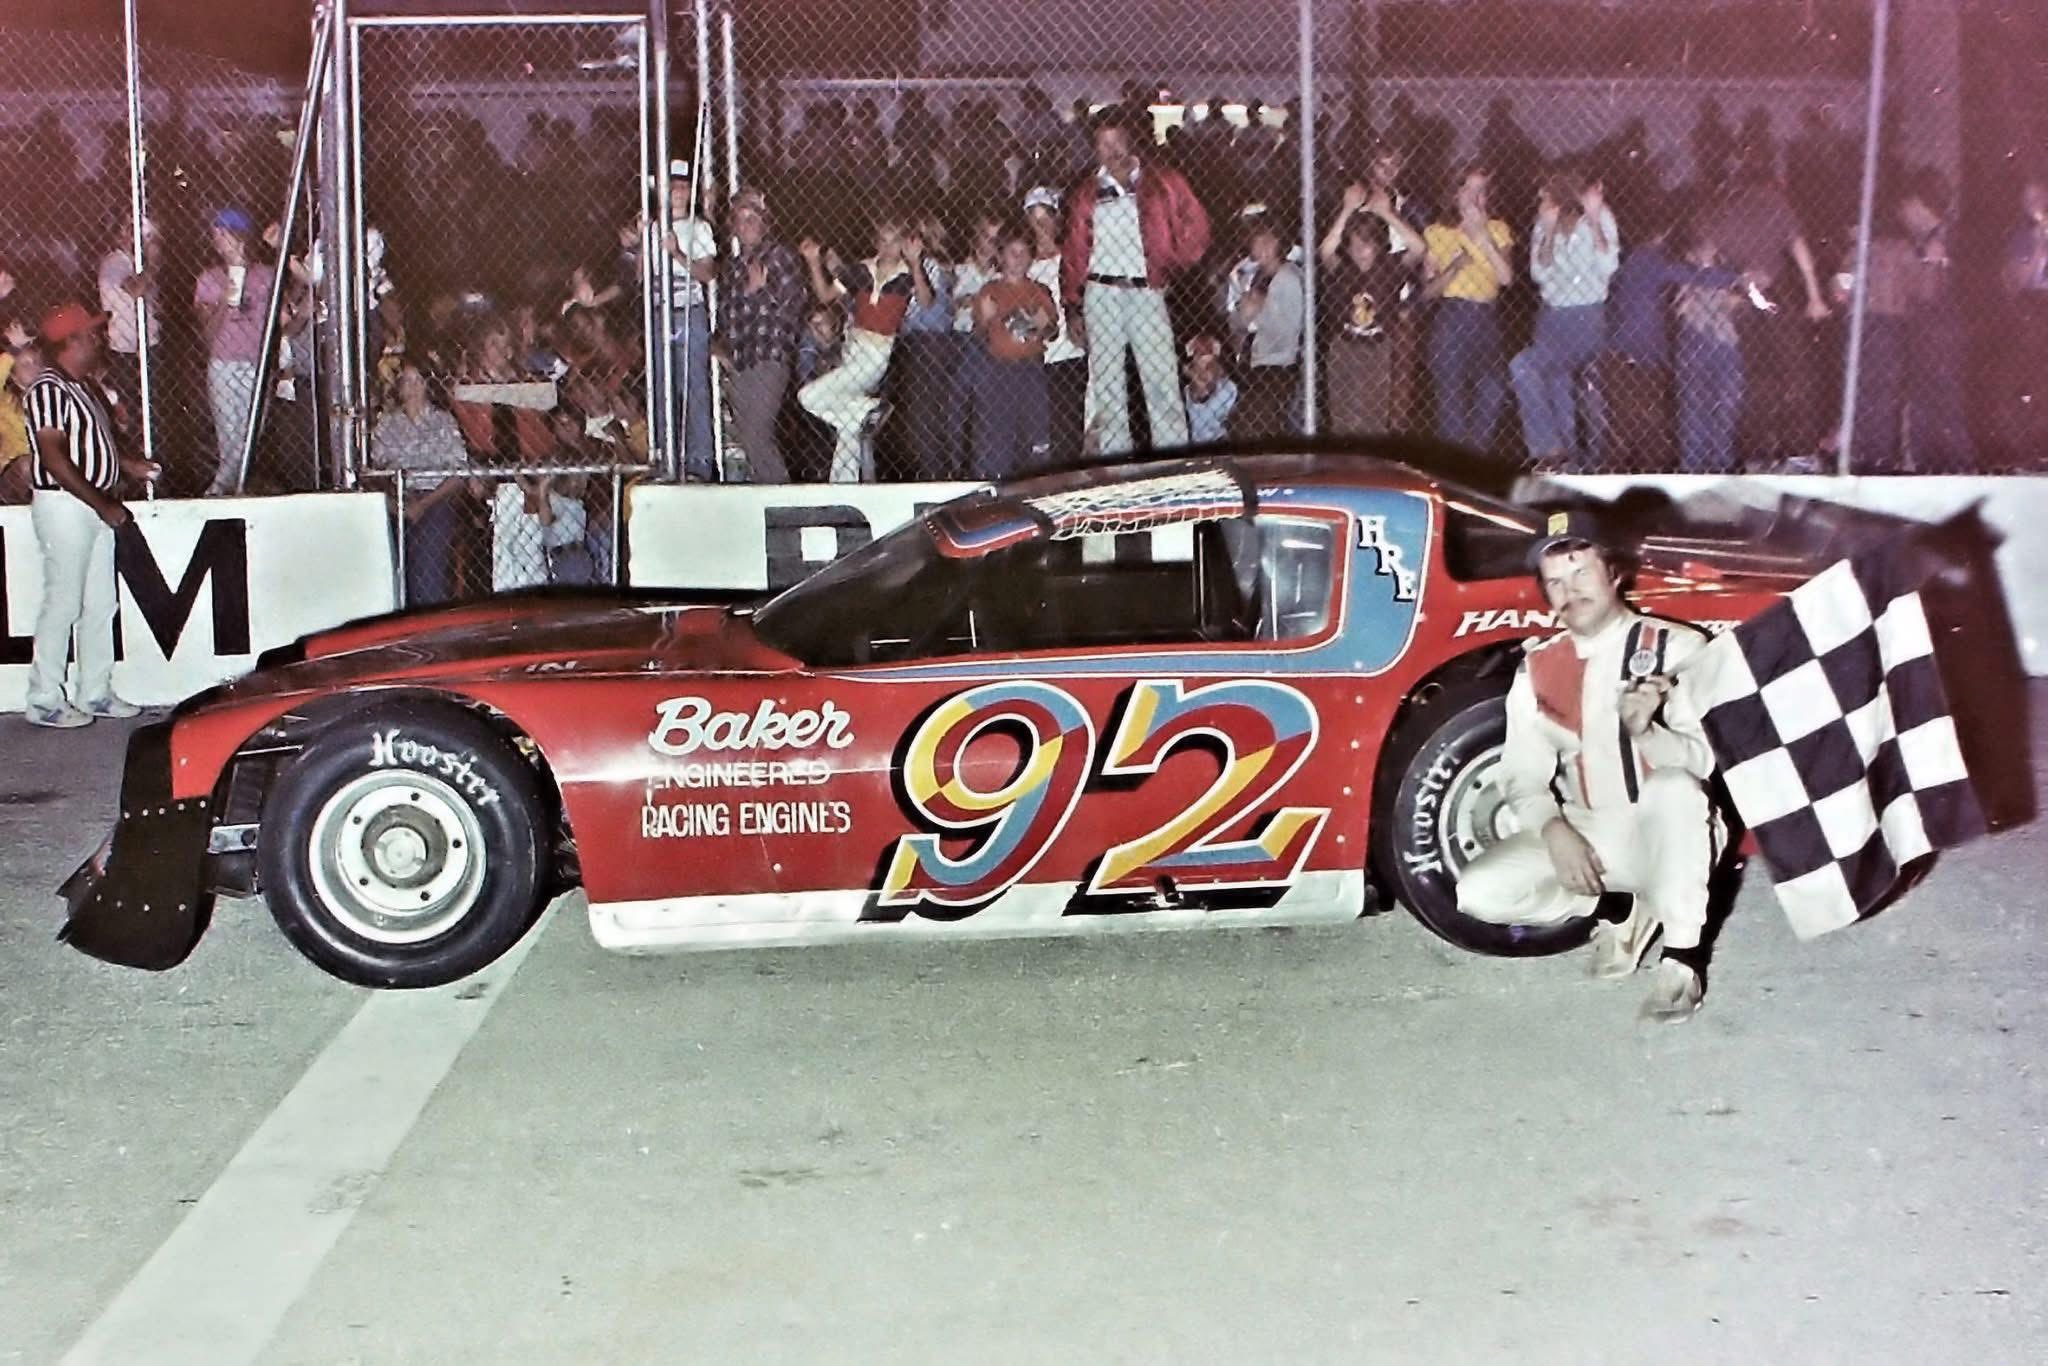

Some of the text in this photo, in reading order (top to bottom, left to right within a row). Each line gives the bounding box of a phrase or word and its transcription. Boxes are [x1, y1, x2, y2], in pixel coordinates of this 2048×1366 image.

[1357, 515, 1418, 602] HRE
[1453, 608, 1568, 638] HAN
[648, 696, 855, 756] Baker
[367, 728, 500, 806] Hoosier
[876, 678, 1332, 908] 92
[641, 800, 851, 838] RACING ENGINES
